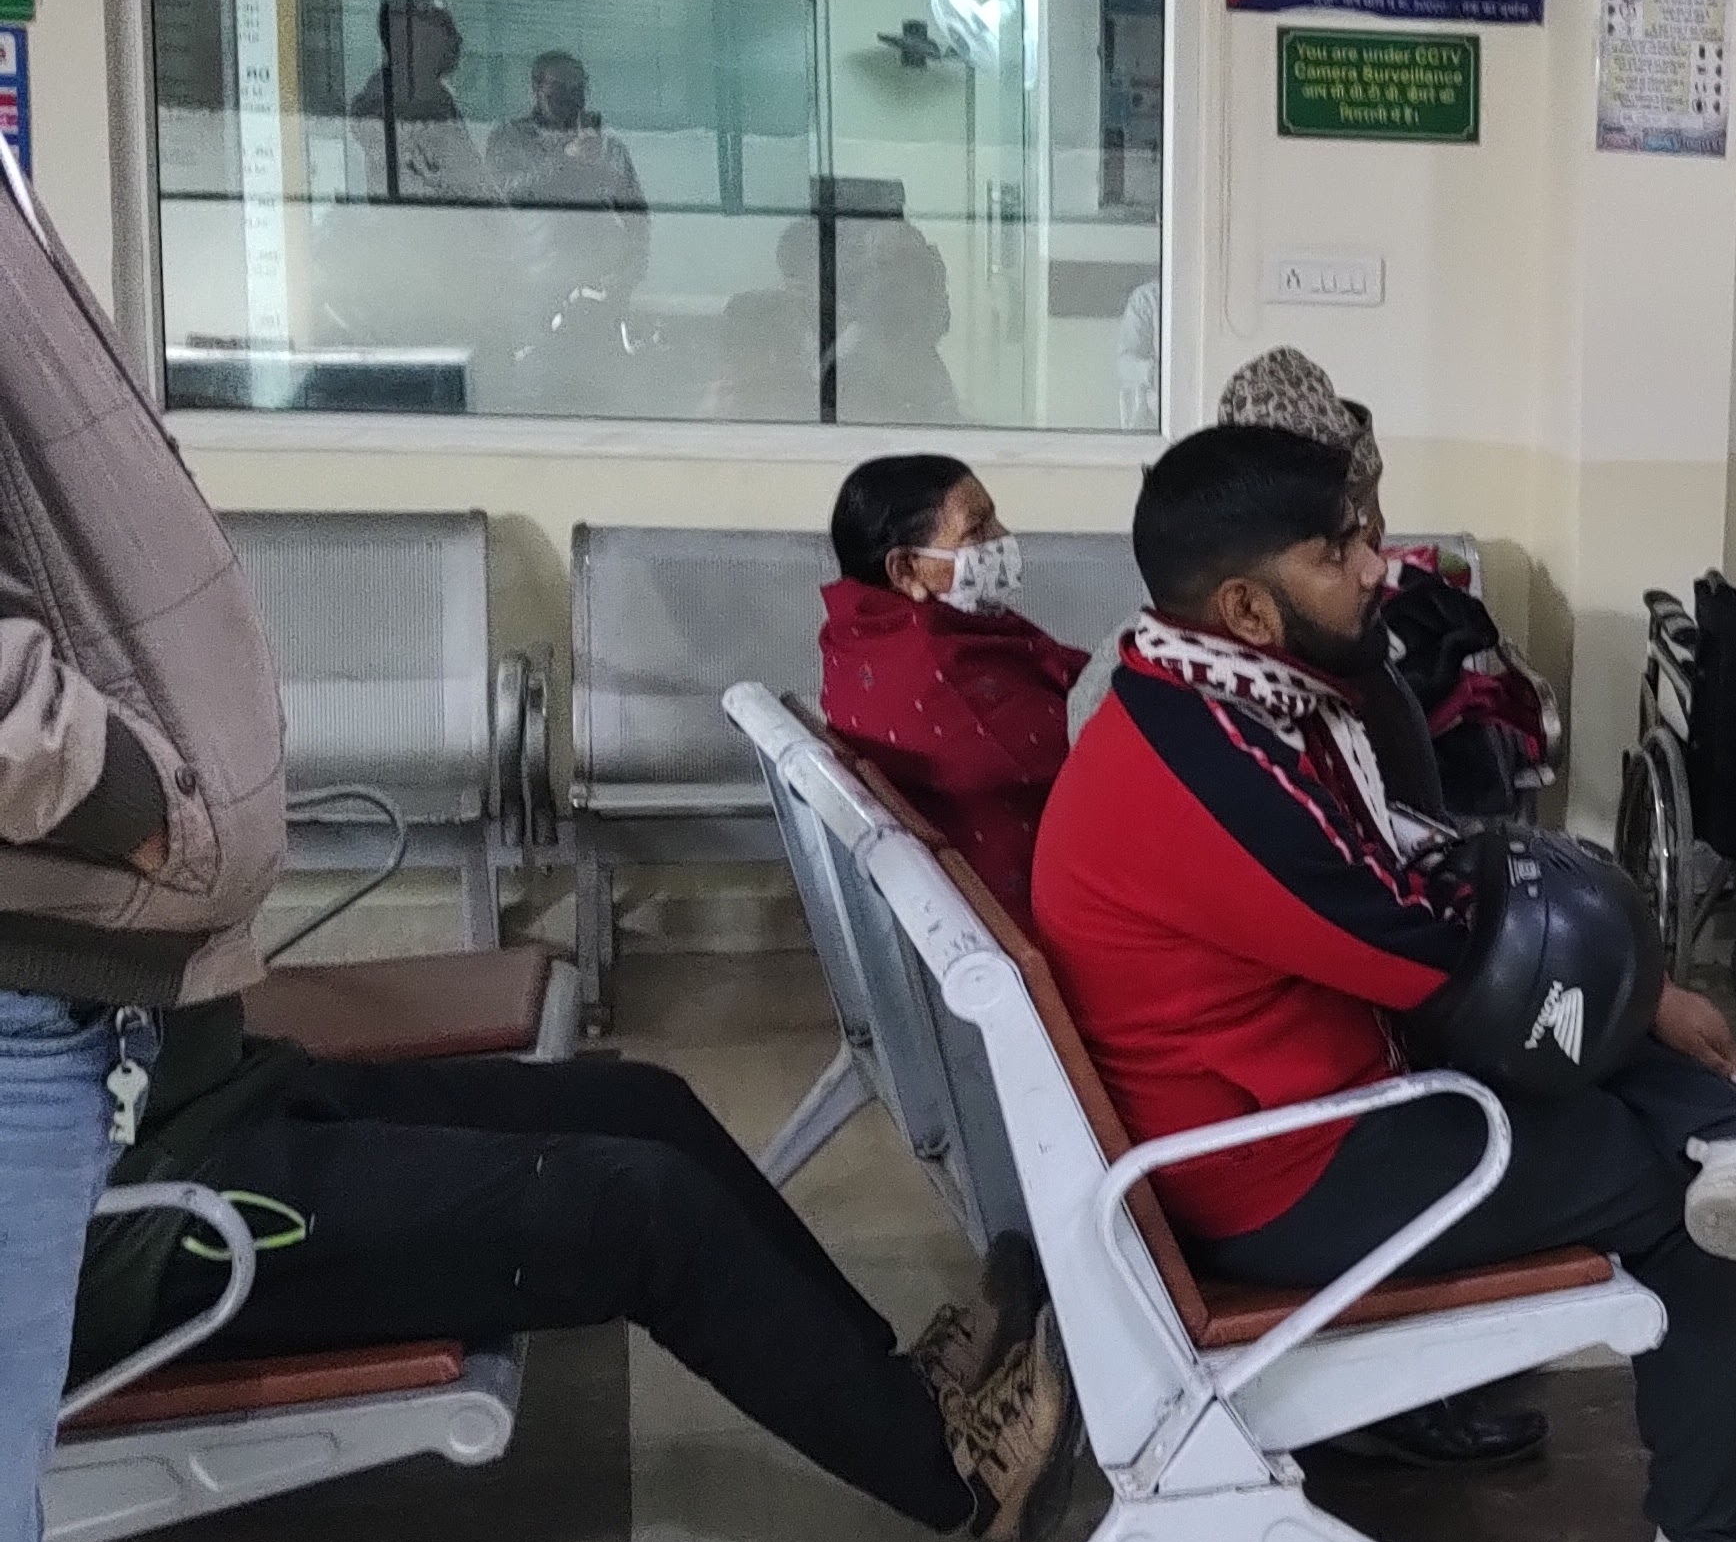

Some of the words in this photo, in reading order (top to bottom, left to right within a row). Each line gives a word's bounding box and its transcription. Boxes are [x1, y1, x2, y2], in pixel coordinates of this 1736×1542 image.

[1296, 40, 1328, 61] You
[1331, 47, 1358, 62] are
[1362, 45, 1409, 64] under
[1415, 46, 1462, 67] CCTV
[1294, 60, 1357, 81] Camera
[1362, 64, 1463, 87] Surveillance
